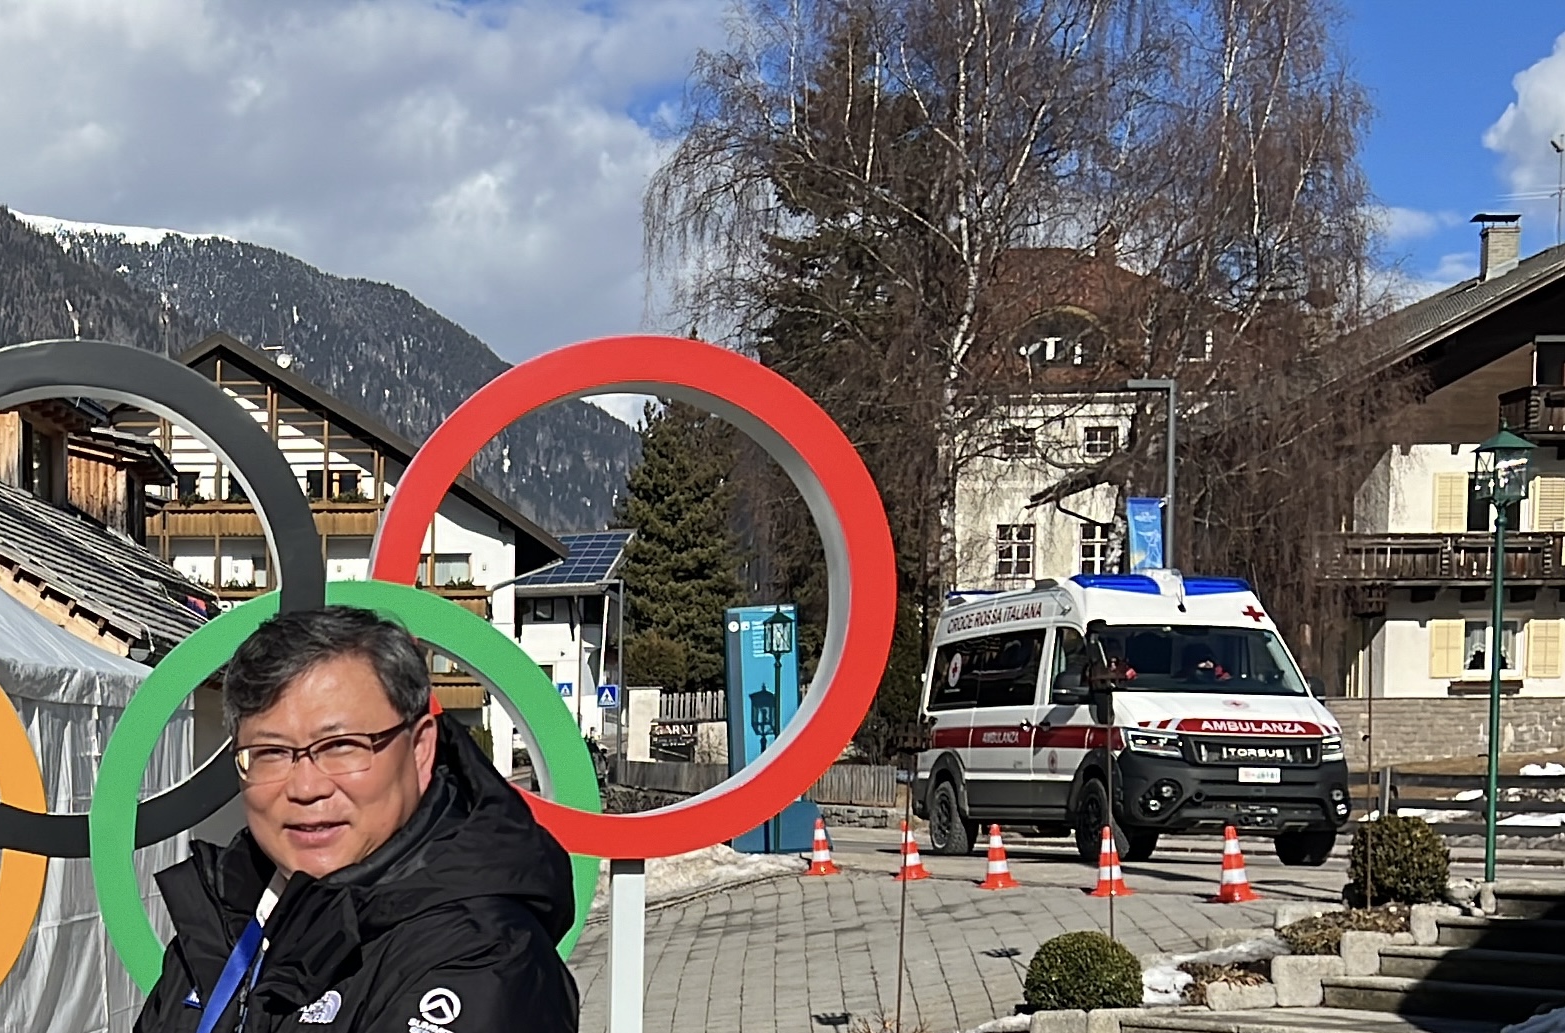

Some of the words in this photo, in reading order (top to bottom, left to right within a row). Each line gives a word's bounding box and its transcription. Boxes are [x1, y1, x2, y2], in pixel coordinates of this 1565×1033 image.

[947, 613, 974, 634] CROCE
[974, 607, 1002, 628] ROSSA
[1002, 602, 1042, 623] ITALIANA
[1201, 720, 1307, 734] AMBULANZA
[982, 731, 1019, 744] AMBULANZA
[1228, 747, 1285, 758] TORSUS
